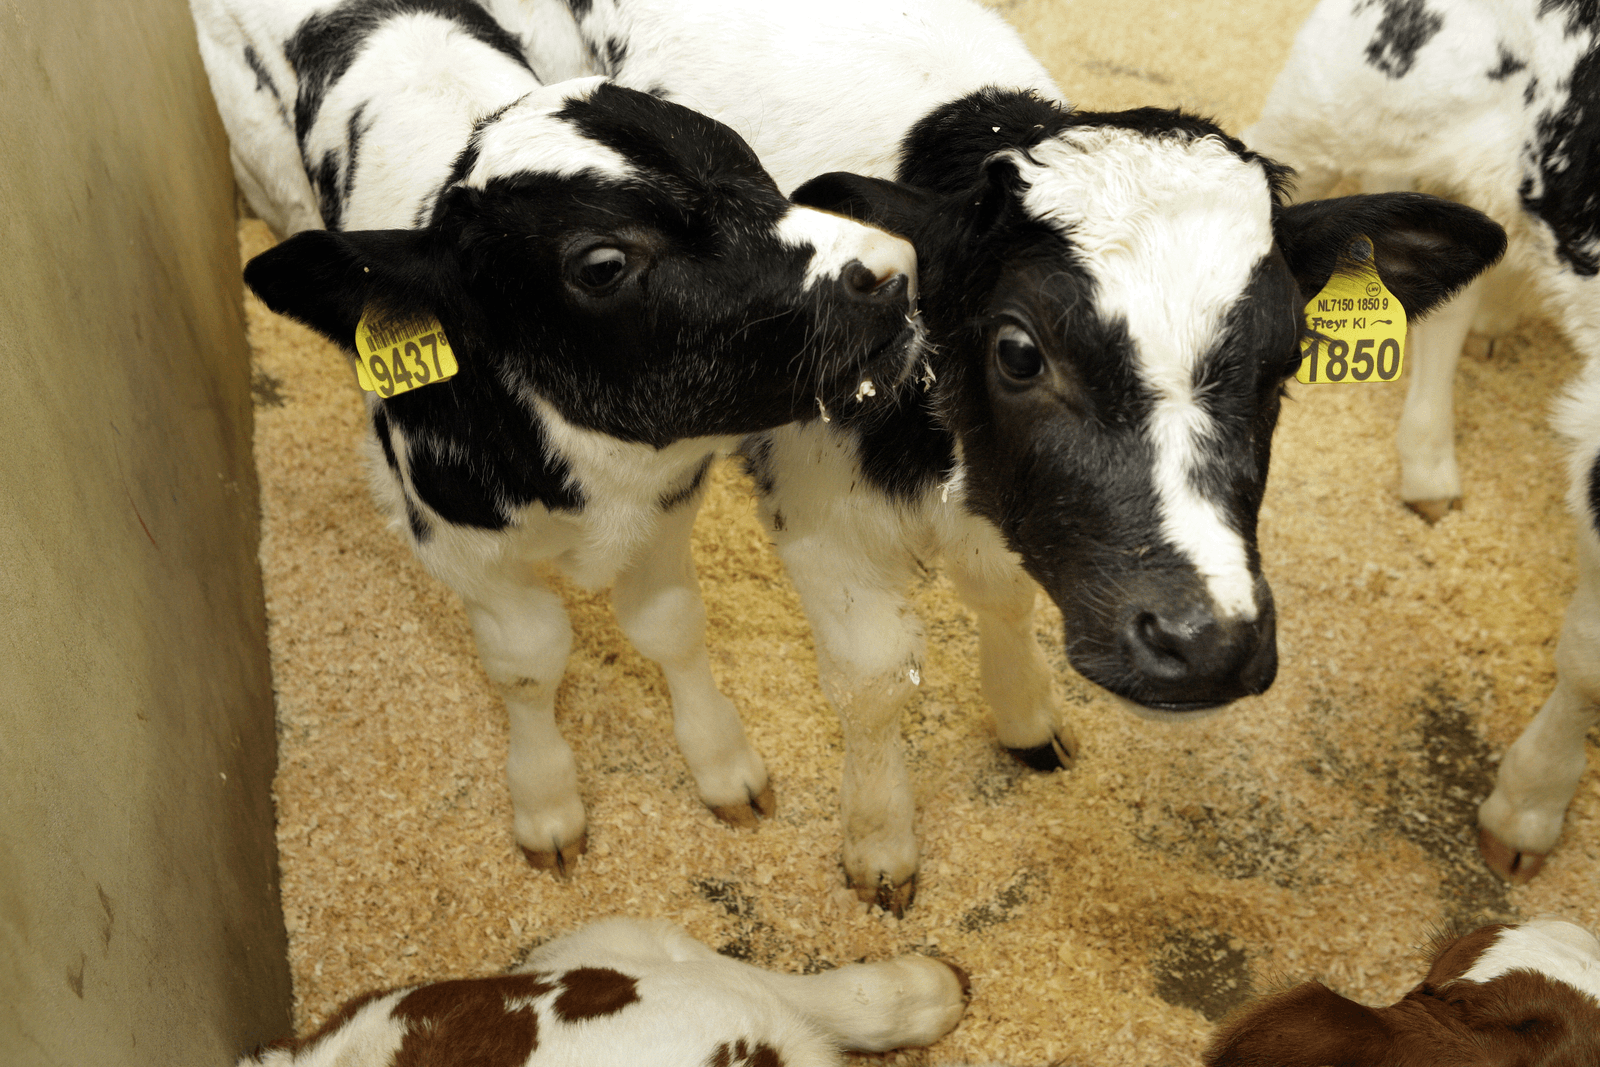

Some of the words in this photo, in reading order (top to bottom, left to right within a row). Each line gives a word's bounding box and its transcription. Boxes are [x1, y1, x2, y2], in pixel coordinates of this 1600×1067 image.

[1318, 299, 1354, 312] NL7150
[1357, 298, 1380, 310] 1850
[1382, 298, 1389, 310] 9
[1312, 317, 1348, 332] Freyr
[1353, 317, 1366, 329] KI
[369, 333, 444, 397] 9437
[1302, 338, 1400, 382] 1850
